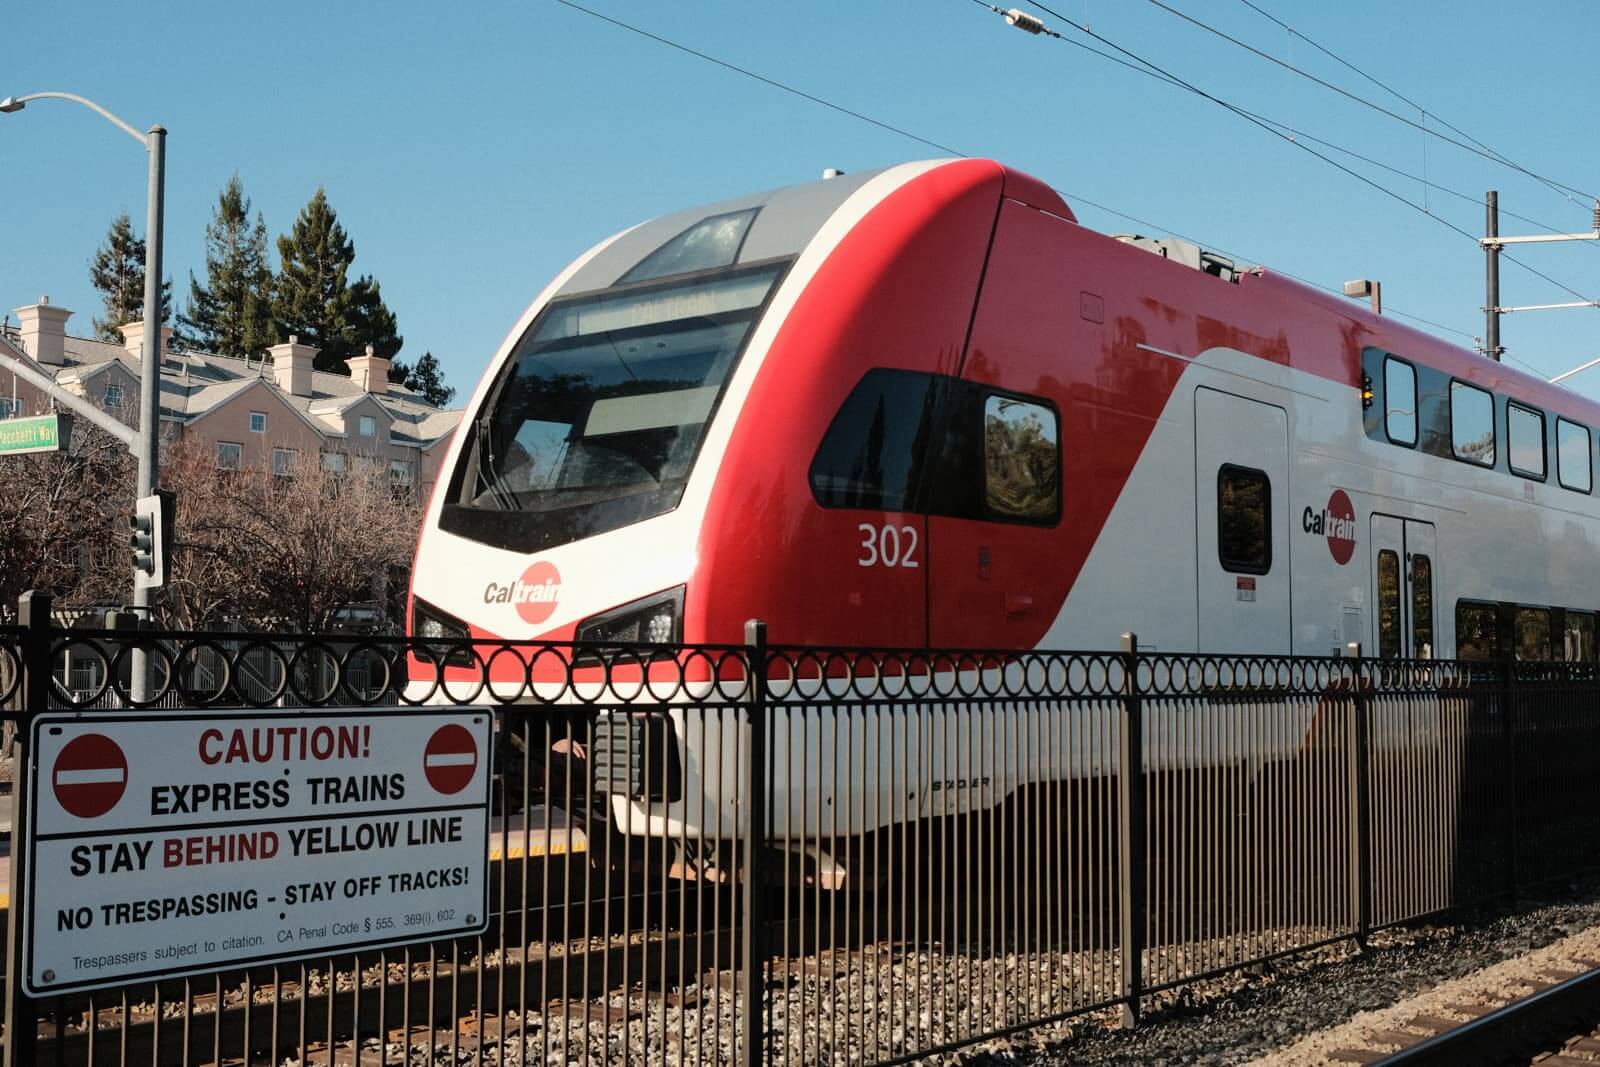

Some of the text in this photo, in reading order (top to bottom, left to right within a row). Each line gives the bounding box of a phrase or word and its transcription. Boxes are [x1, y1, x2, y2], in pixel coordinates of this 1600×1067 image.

[39, 424, 55, 443] Way
[1302, 505, 1356, 541] Caltrain
[858, 523, 919, 568] 302
[484, 578, 561, 604] Caltrain
[199, 725, 371, 766] CAUTION!
[150, 773, 405, 816] EXPRESS TRAINS
[931, 776, 990, 791] SADER
[70, 817, 463, 877] STAY BEHIND YELLOW LINE
[57, 907, 93, 932] NO
[101, 889, 258, 926] TRESPASSING
[285, 881, 336, 905] STAY
[343, 876, 381, 898] OFF
[388, 867, 469, 893] TRACKS!
[72, 952, 147, 970] Trespassers
[154, 943, 198, 961] subject
[204, 942, 216, 952] to
[222, 935, 265, 950] citation.
[277, 929, 294, 943] CA
[299, 923, 327, 940] Penal
[332, 920, 359, 936] Code
